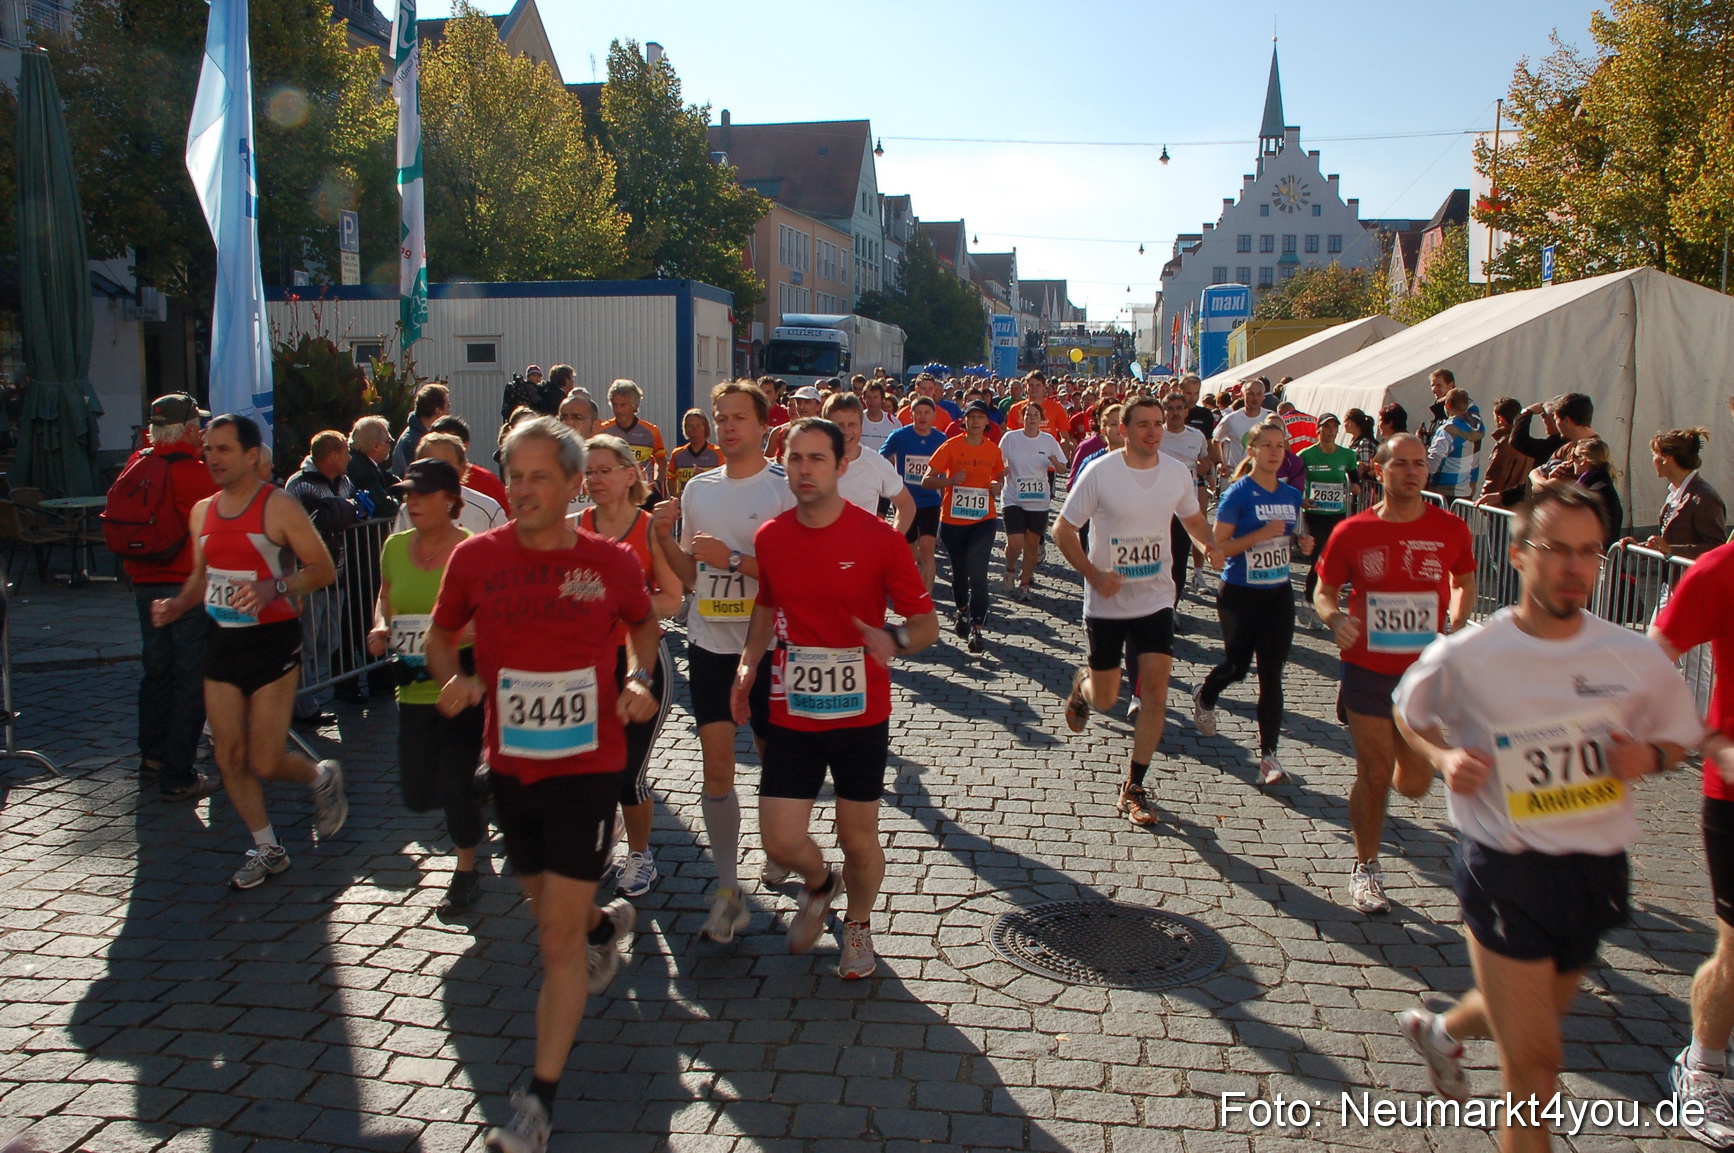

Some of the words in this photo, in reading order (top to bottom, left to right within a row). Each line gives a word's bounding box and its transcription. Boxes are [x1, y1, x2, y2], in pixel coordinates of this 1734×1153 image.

[343, 216, 354, 245] P
[1544, 251, 1551, 276] P
[1211, 293, 1246, 311] maxi
[908, 463, 929, 475] 299
[1020, 482, 1044, 492] 2113
[1314, 490, 1340, 501] 2632
[956, 495, 985, 509] 2119
[1255, 504, 1296, 515] HUBER
[960, 508, 979, 517] Helga
[1117, 544, 1160, 565] 2440
[1253, 548, 1288, 568] 2060
[1253, 570, 1269, 579] Eva
[208, 583, 241, 605] 218
[709, 574, 745, 597] 771
[713, 600, 745, 613] Horst
[1374, 608, 1431, 632] 3502
[793, 665, 857, 693] 2918
[508, 693, 586, 727] 3449
[792, 694, 859, 710] Sebastian
[1525, 738, 1604, 787] 370
[1528, 780, 1617, 815] Andreas
